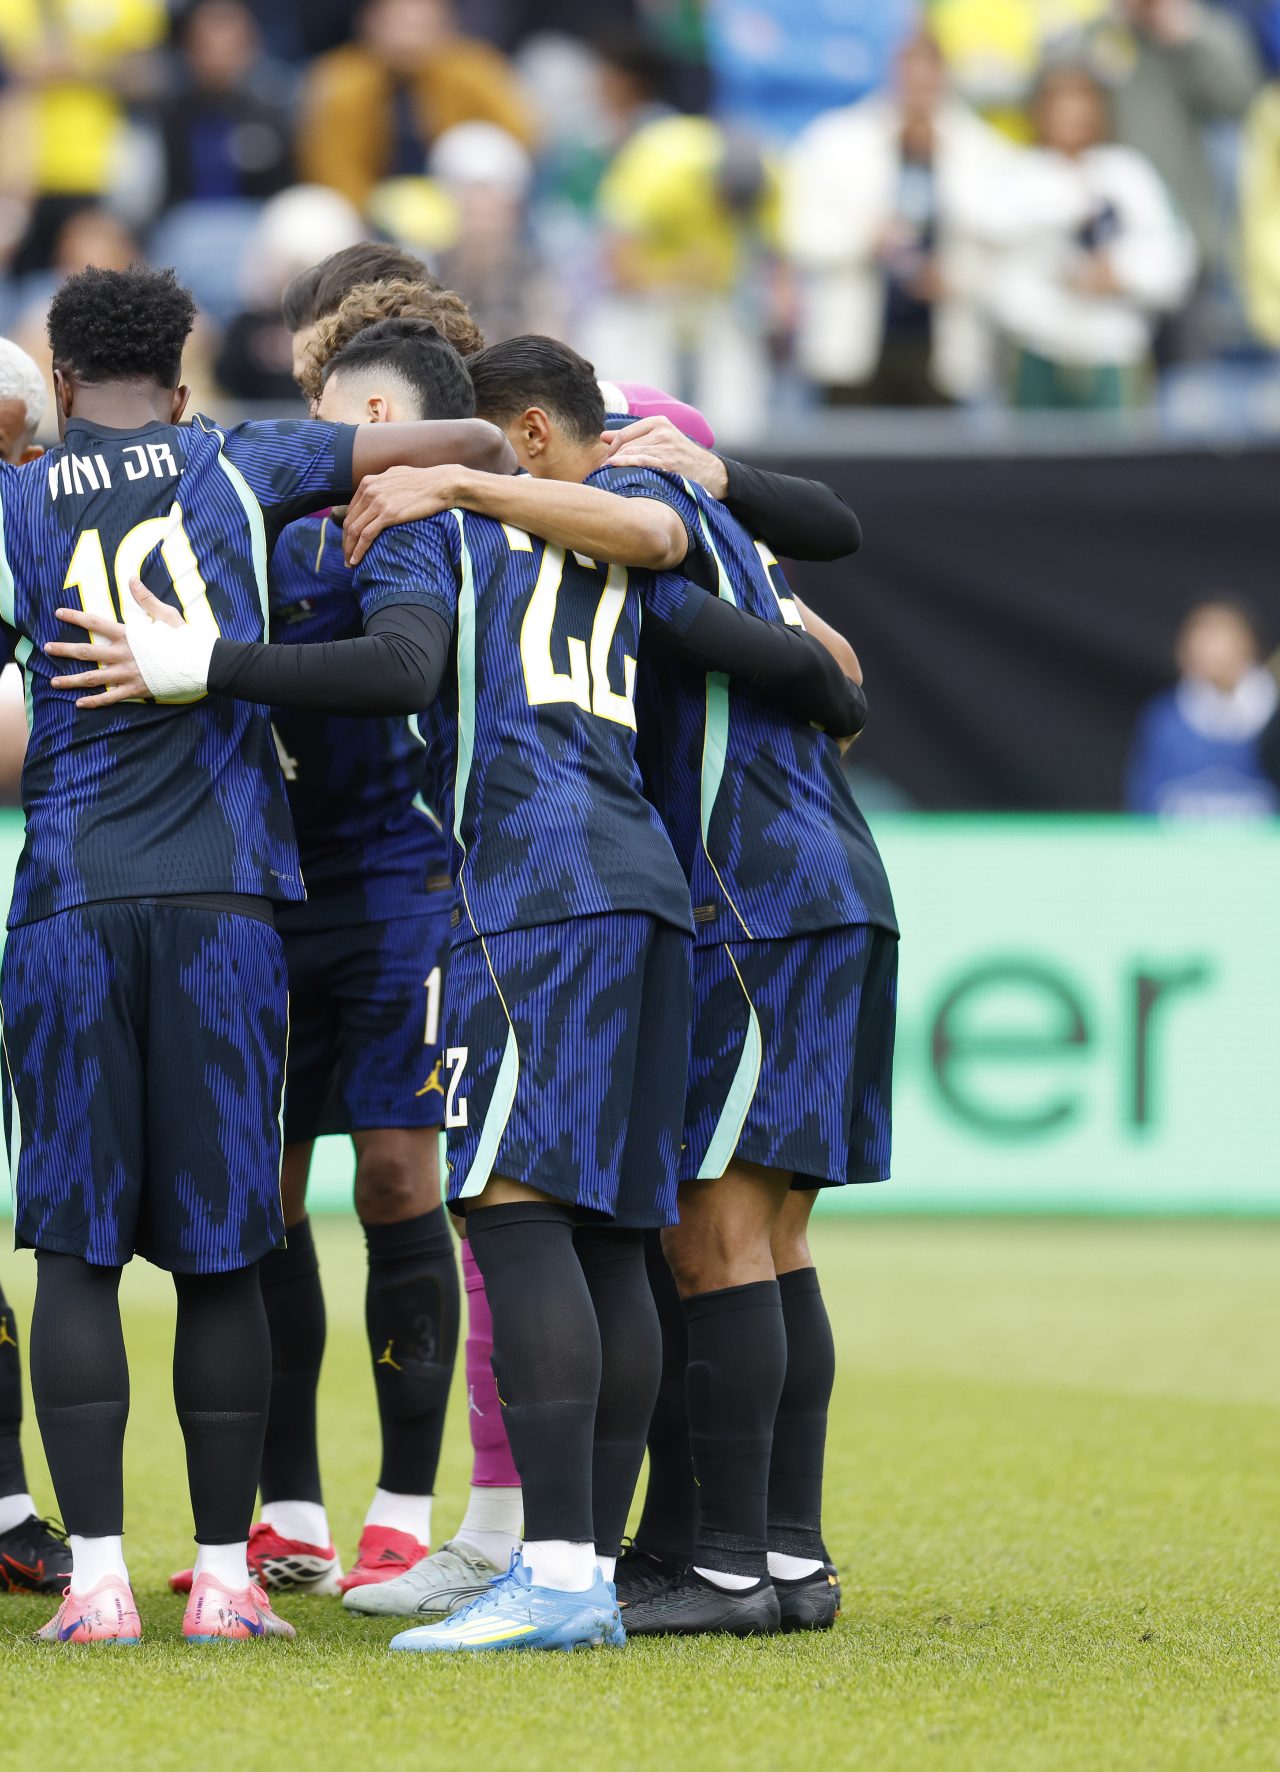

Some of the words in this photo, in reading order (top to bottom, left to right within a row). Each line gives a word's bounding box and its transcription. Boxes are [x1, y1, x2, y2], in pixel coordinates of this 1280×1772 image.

[48, 452, 112, 501] VINI
[62, 500, 222, 704] 10
[501, 522, 638, 733] 22
[443, 1046, 469, 1129] 2
[928, 958, 1215, 1143] er
